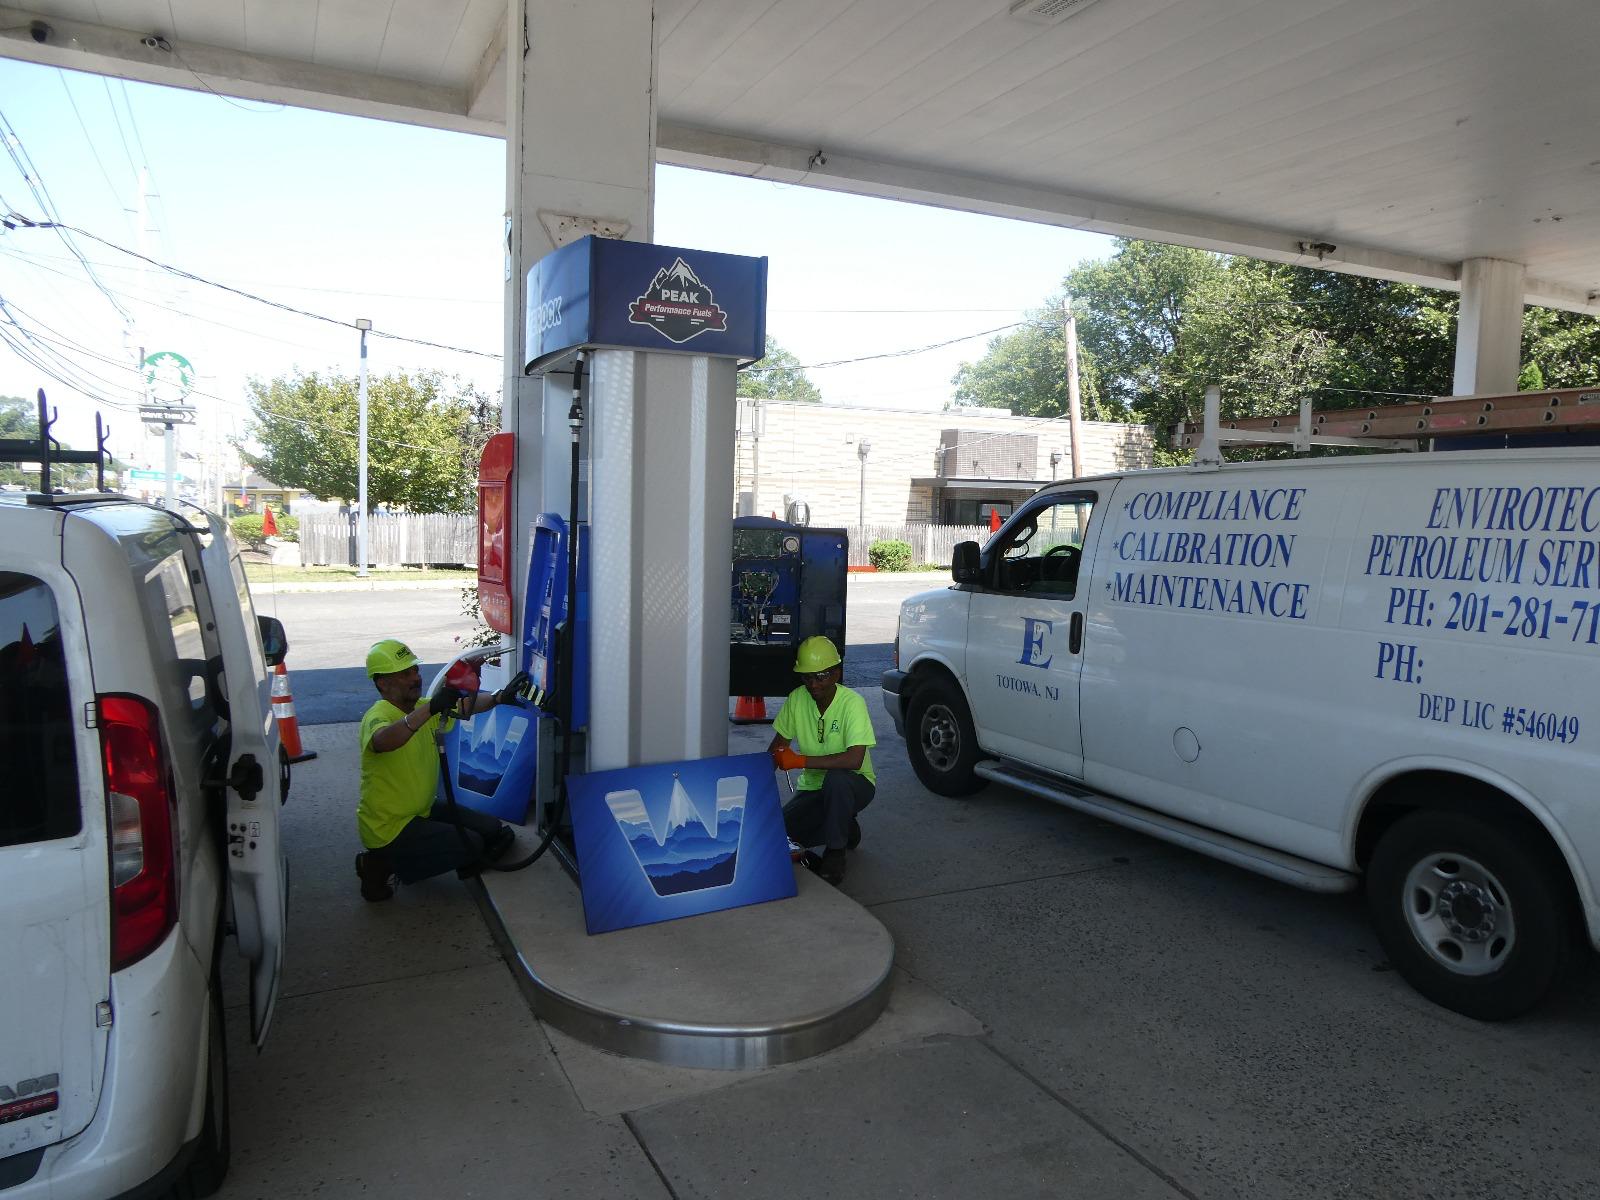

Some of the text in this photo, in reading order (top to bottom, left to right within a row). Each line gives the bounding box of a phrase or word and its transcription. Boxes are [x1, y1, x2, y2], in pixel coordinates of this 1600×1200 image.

[645, 303, 712, 317] Performance Fuels
[661, 289, 699, 303] PEAK
[1364, 534, 1600, 590] PETROLEUM SER
[1384, 586, 1434, 627] PH:
[1374, 641, 1424, 684] PH:
[1045, 685, 1059, 700] NJ
[1418, 692, 1580, 744] DEP LIC #546049
